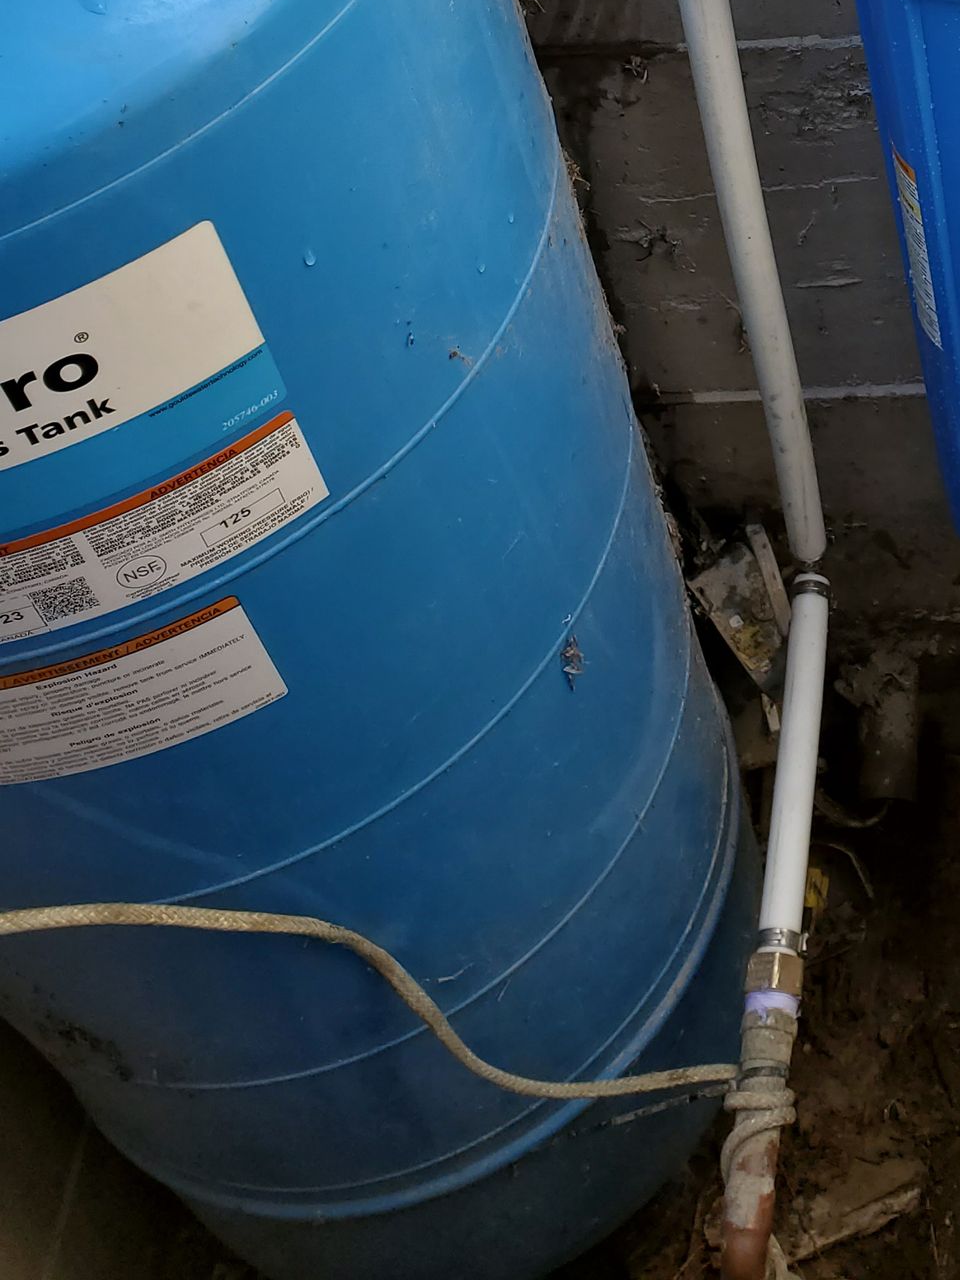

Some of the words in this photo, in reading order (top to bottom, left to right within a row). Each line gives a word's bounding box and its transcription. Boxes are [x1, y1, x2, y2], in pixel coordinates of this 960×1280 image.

[15, 398, 117, 446] Tank
[219, 389, 280, 431] 205746-003
[148, 447, 237, 499] ADVERTENCIA
[218, 469, 261, 496] PERSONALES
[179, 546, 215, 567] MAXIMUM
[215, 525, 251, 550] WORKING
[251, 503, 289, 529] PRESSURE
[189, 546, 227, 567] PRESSION
[239, 521, 269, 541] SERVICE
[270, 498, 305, 523] MAXIMALE
[218, 505, 252, 530] 125
[198, 548, 232, 568] PRESIÓN
[232, 542, 243, 550] DE
[244, 521, 278, 544] TRABAJO
[122, 559, 160, 583] NSF
[12, 649, 120, 685] AVERTISSEMENT
[133, 606, 220, 649] ADVERTENCIA
[35, 674, 82, 691] Explosion
[84, 663, 117, 677] Hazard
[85, 685, 138, 710] d'explosion
